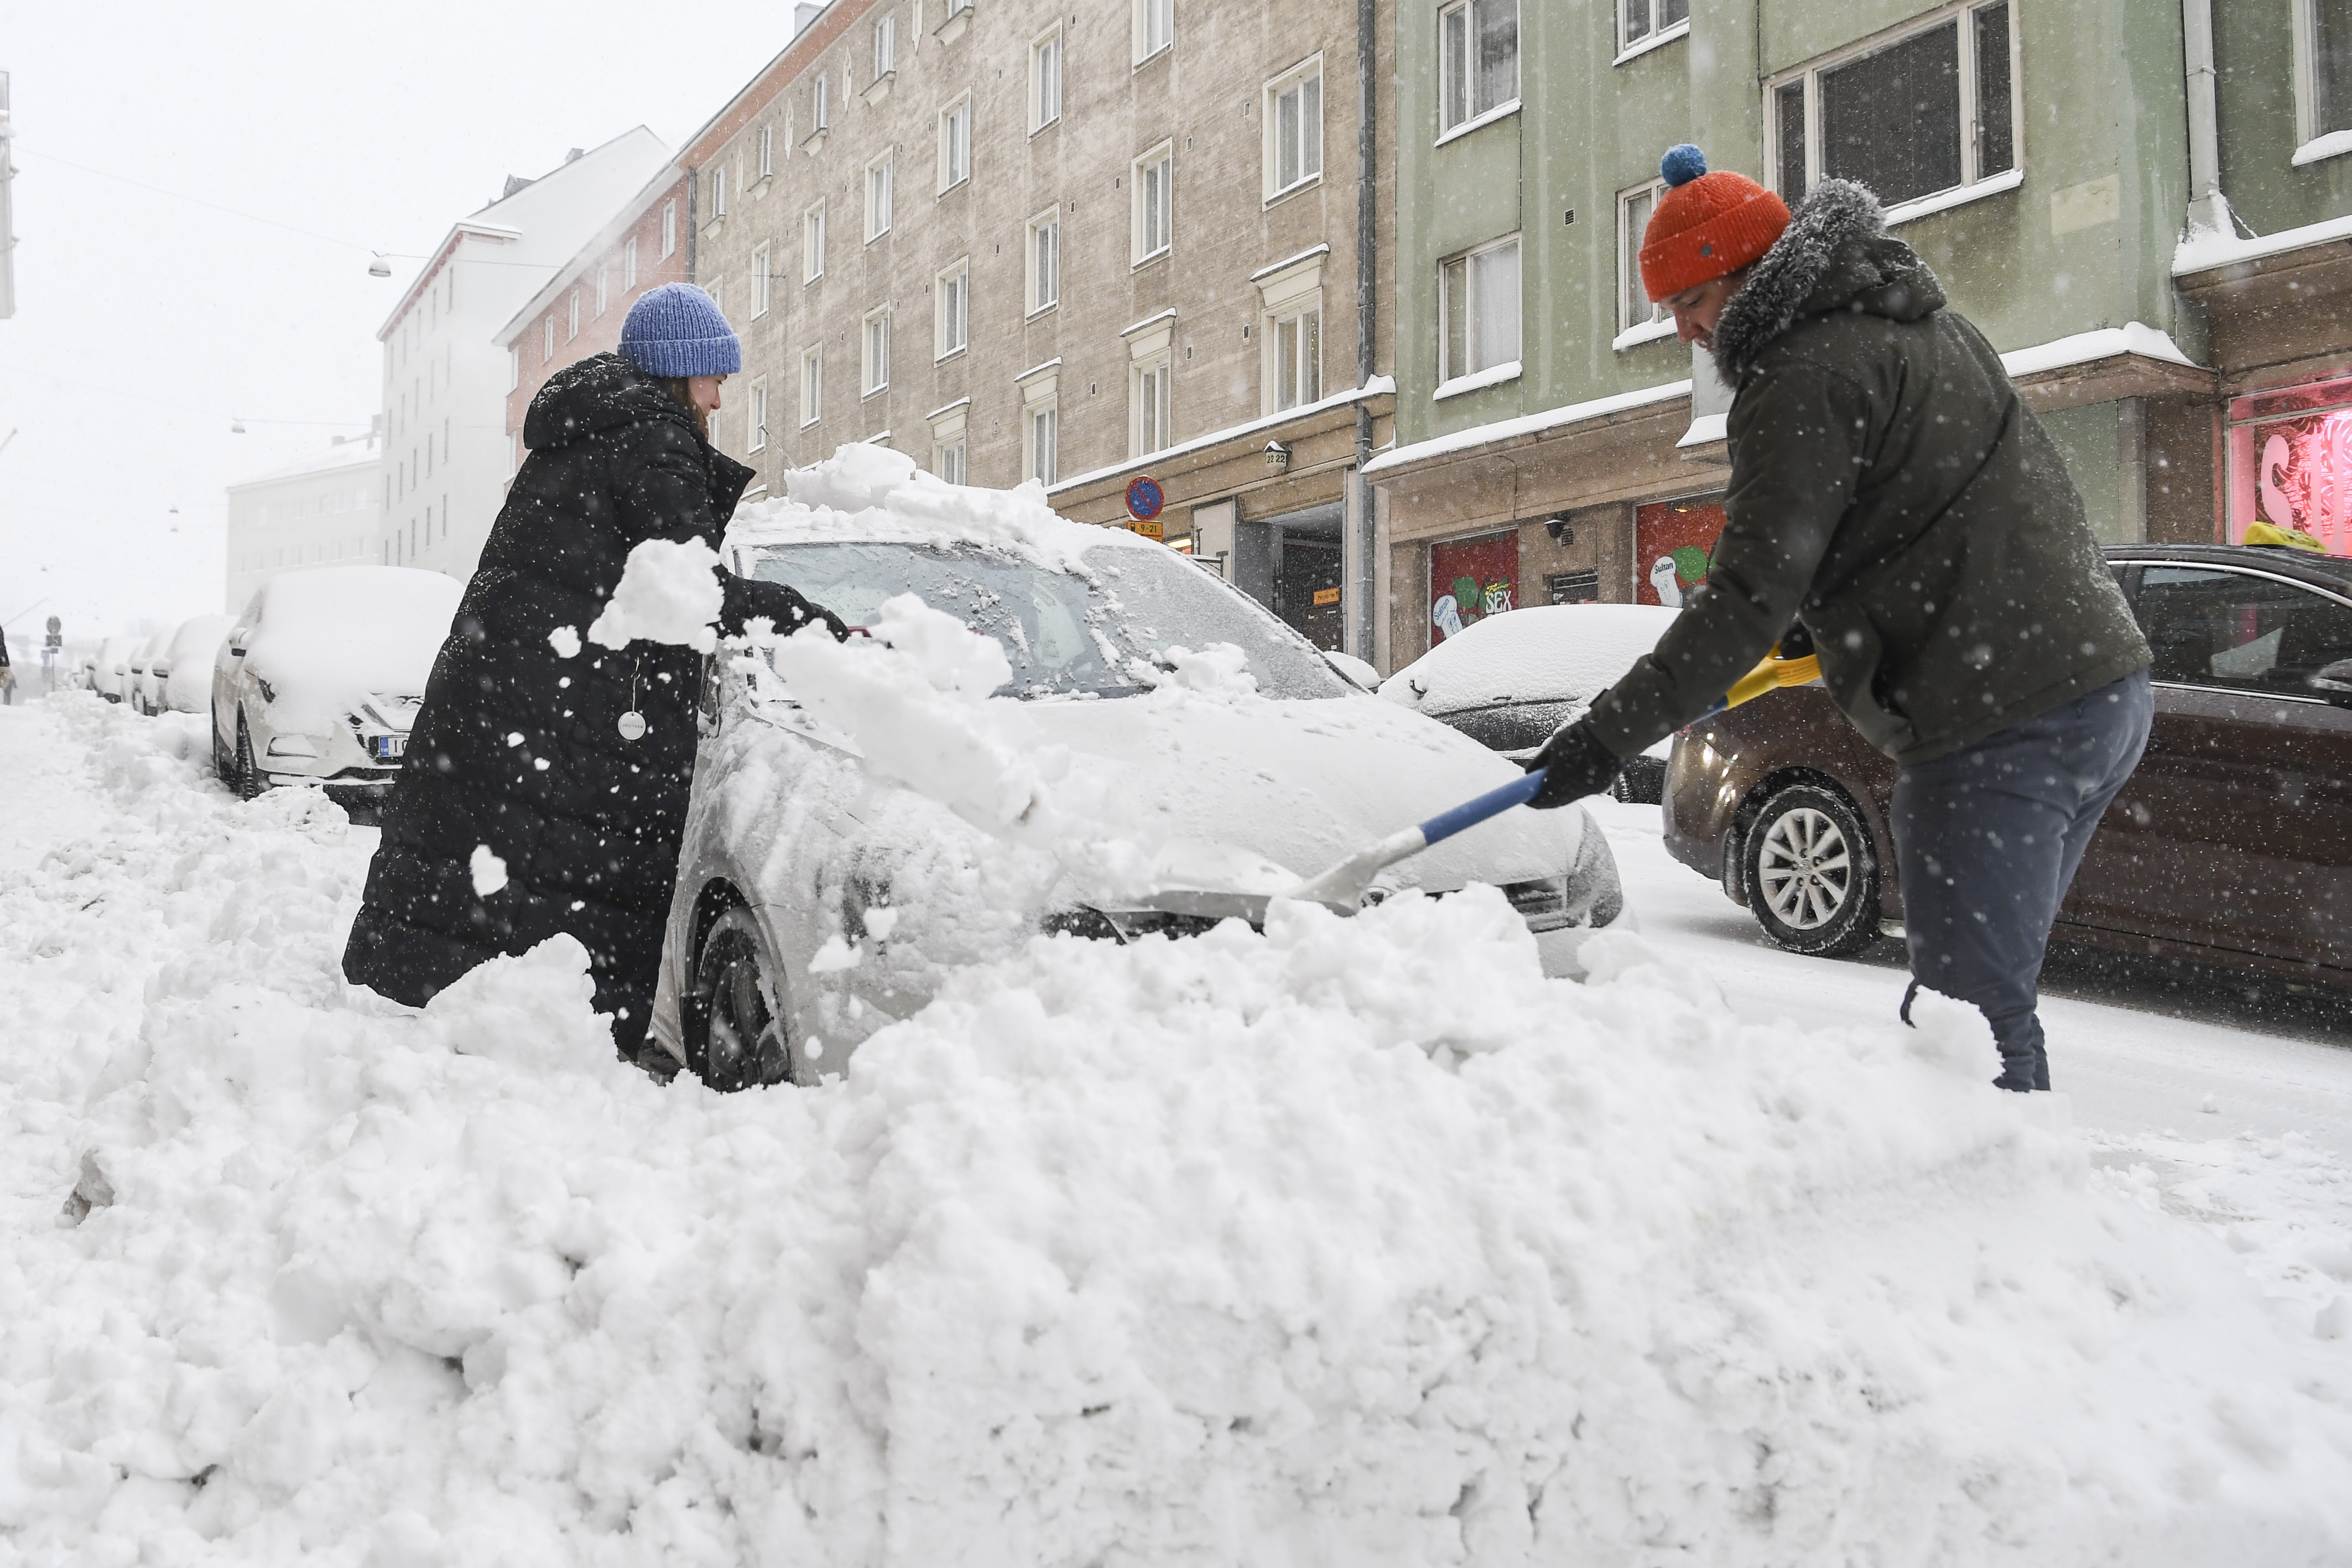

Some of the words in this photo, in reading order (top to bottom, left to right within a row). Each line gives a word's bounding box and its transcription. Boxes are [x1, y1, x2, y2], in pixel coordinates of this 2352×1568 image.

[1267, 455, 1274, 463] 22
[1275, 454, 1286, 463] 22
[1654, 562, 1673, 574] Sultan
[1486, 590, 1512, 613] SEX
[1434, 598, 1450, 620] Sultan
